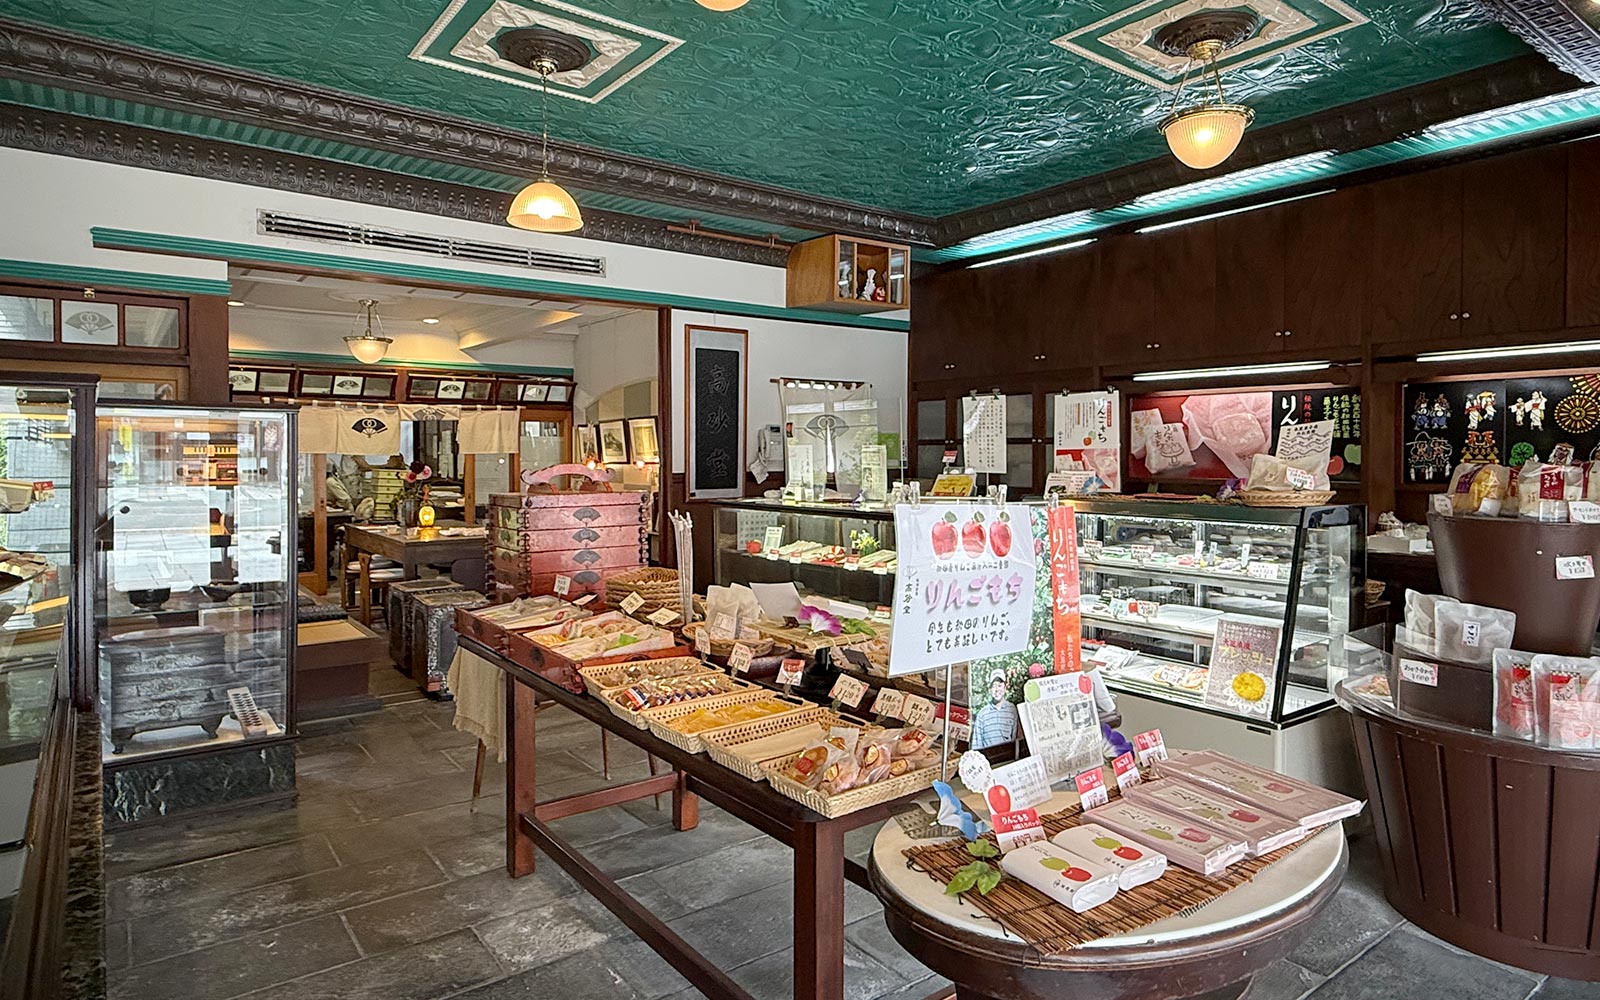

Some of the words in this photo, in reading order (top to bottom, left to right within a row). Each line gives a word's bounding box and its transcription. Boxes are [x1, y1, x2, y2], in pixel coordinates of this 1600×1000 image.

[705, 363, 730, 479] 高砂堂
[925, 571, 1023, 614] りんごもち
[1052, 528, 1070, 616] りんごもち
[1001, 813, 1029, 825] りんごもち
